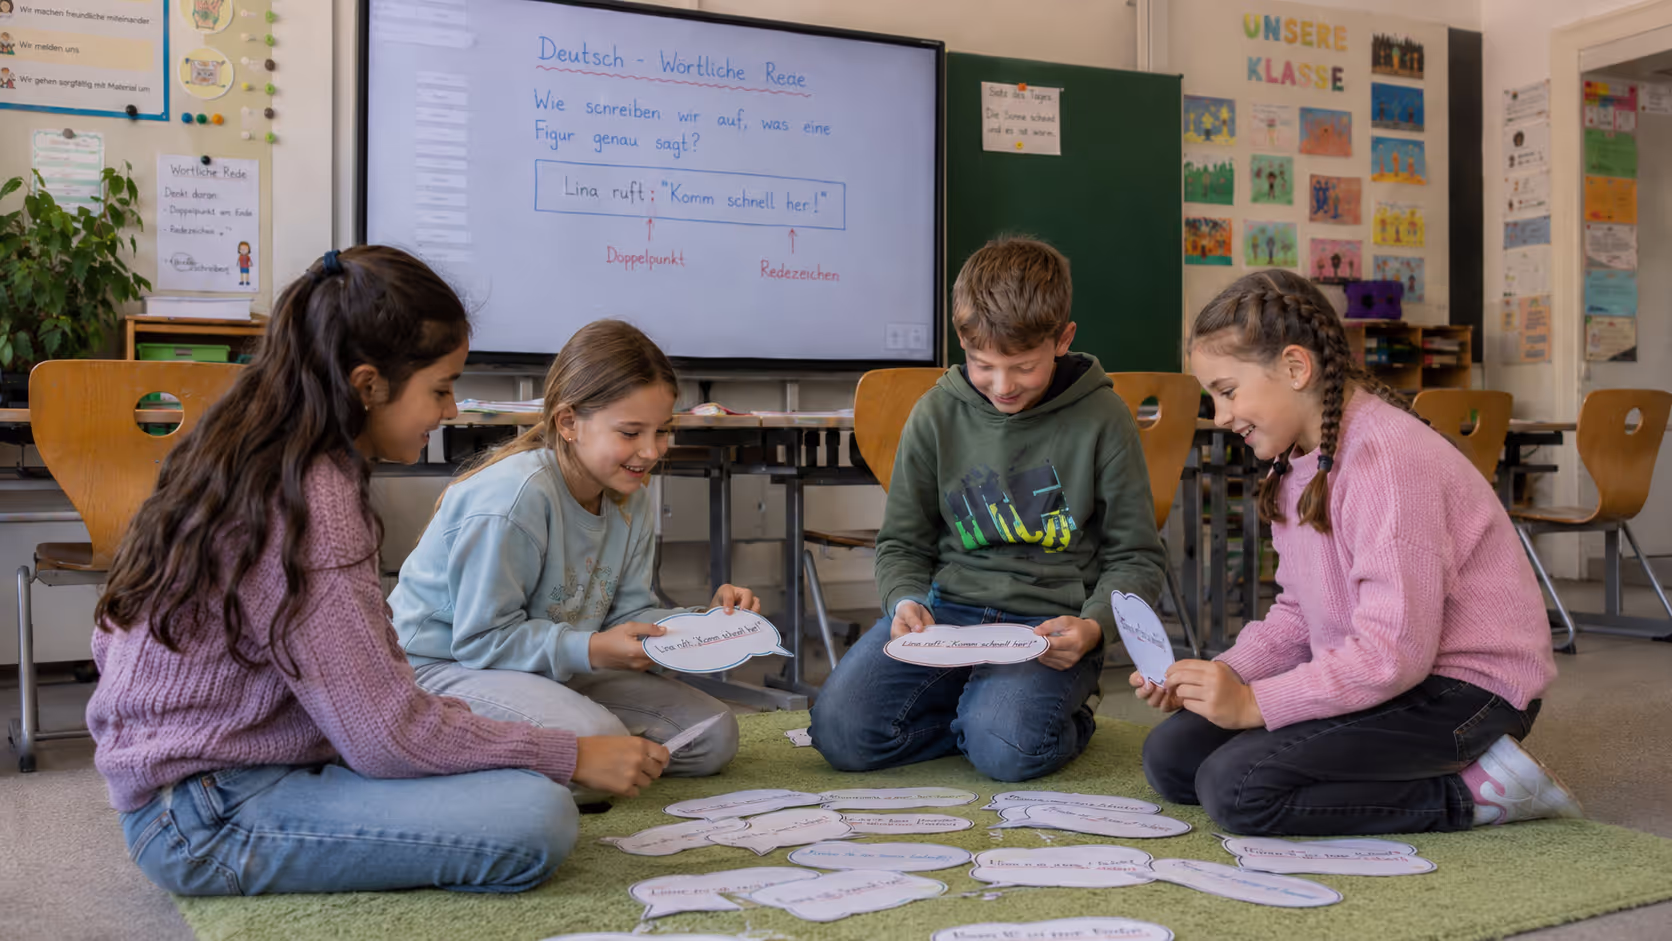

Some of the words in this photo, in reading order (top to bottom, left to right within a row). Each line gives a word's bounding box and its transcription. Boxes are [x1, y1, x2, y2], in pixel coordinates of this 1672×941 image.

[34, 9, 64, 17] machen
[66, 10, 105, 20] freundliche
[20, 41, 32, 49] Wir
[35, 43, 63, 53] melden
[1243, 13, 1348, 51] UNSERE
[537, 36, 624, 68] Deutsch
[660, 50, 746, 81] Wörtliche
[1247, 56, 1345, 92] KLASSE
[35, 77, 57, 86] gehen
[534, 88, 566, 111] Wie
[678, 110, 701, 122] wir
[717, 108, 748, 131] auf,
[761, 119, 790, 131] was
[803, 121, 832, 136] eine
[535, 119, 575, 151] Figur
[593, 133, 639, 153] genau
[655, 132, 701, 159] sagt?
[223, 166, 247, 179] Rede
[565, 175, 599, 199] Lina
[661, 180, 715, 206] "Komm
[727, 187, 776, 210] schnell
[786, 191, 828, 214] her!"
[606, 245, 686, 272] Doppelpunkt
[760, 258, 841, 283] Redezeichen
